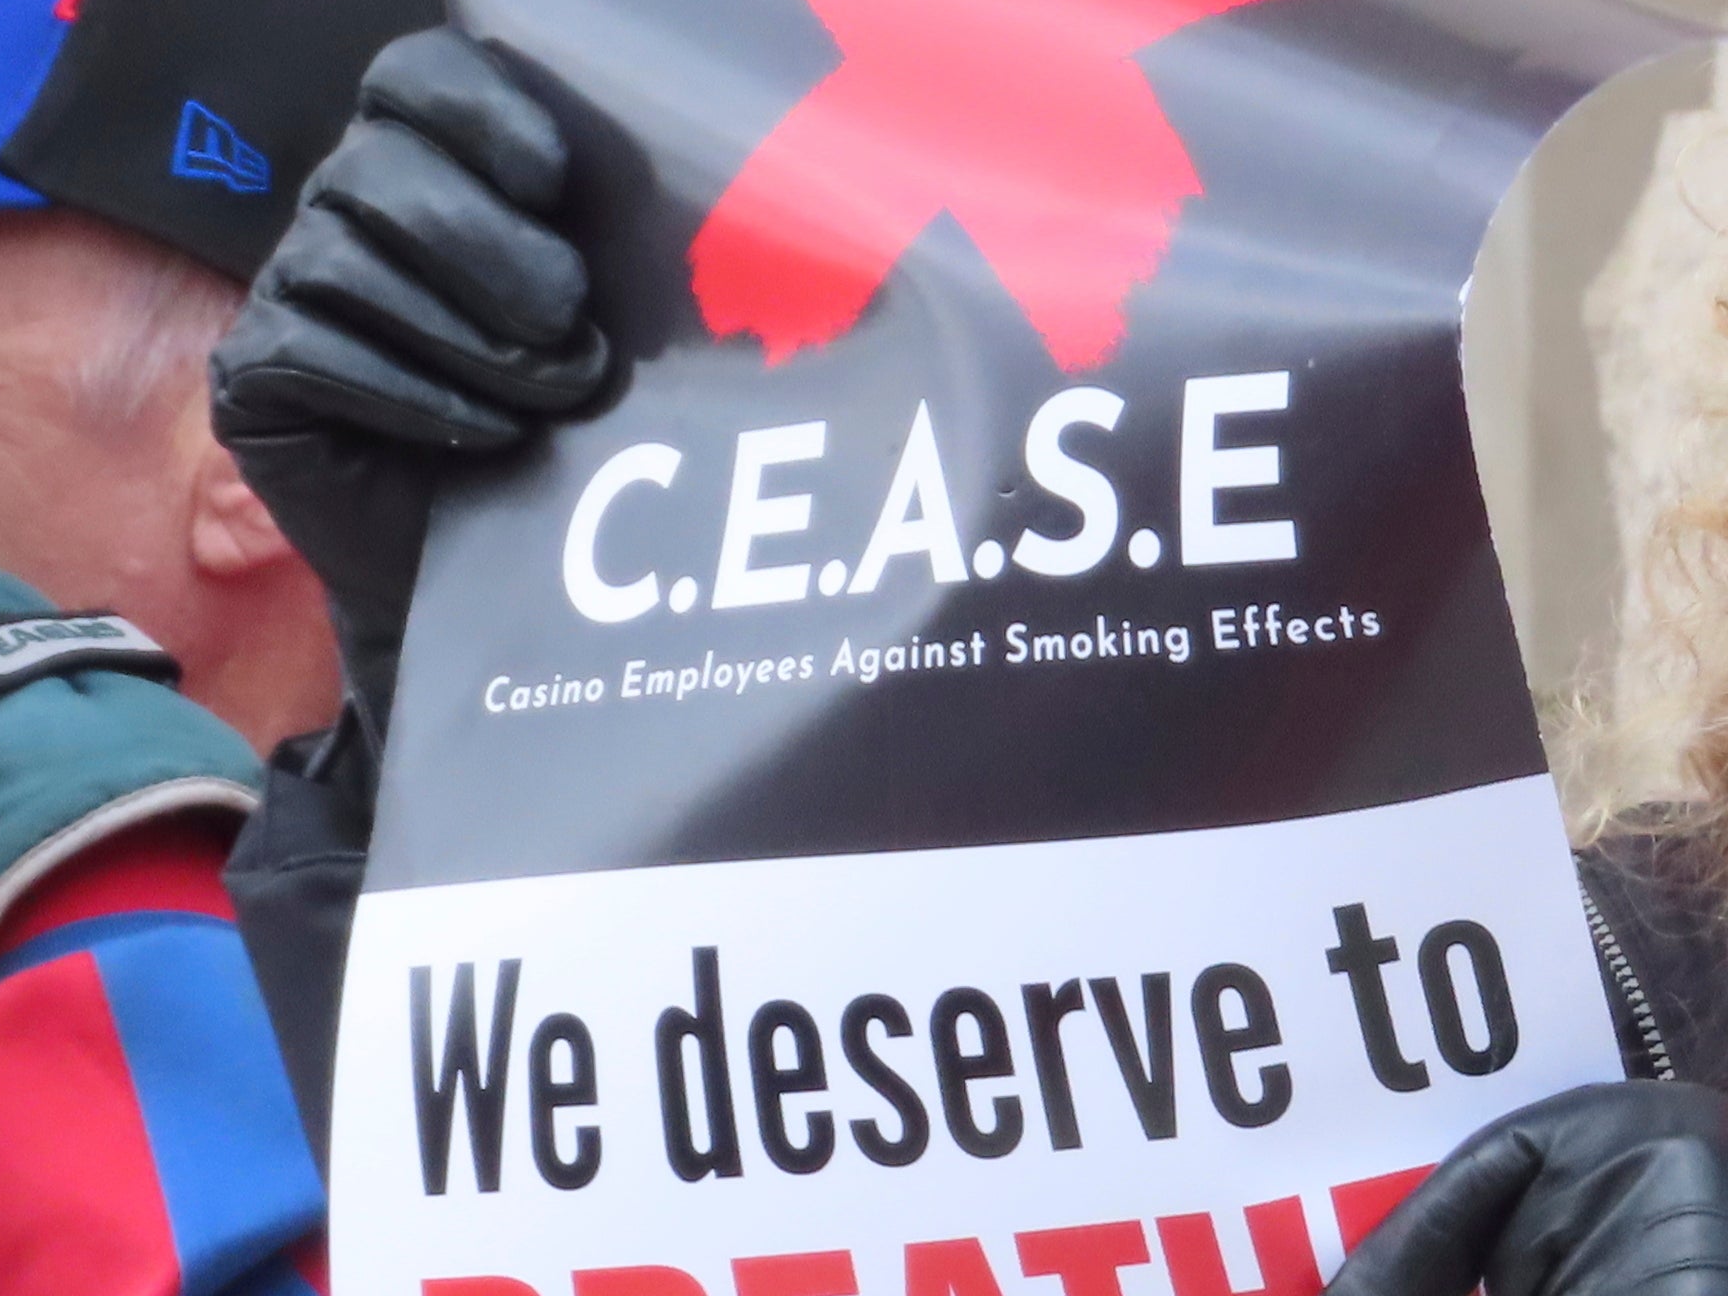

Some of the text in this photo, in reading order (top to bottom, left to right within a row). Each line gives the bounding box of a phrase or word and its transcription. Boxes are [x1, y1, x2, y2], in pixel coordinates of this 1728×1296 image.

[562, 370, 1299, 624] C.E.A.S.E
[484, 602, 1381, 714] Casino Employees Against Smoking Effects
[408, 903, 1522, 1198] We deserve to
